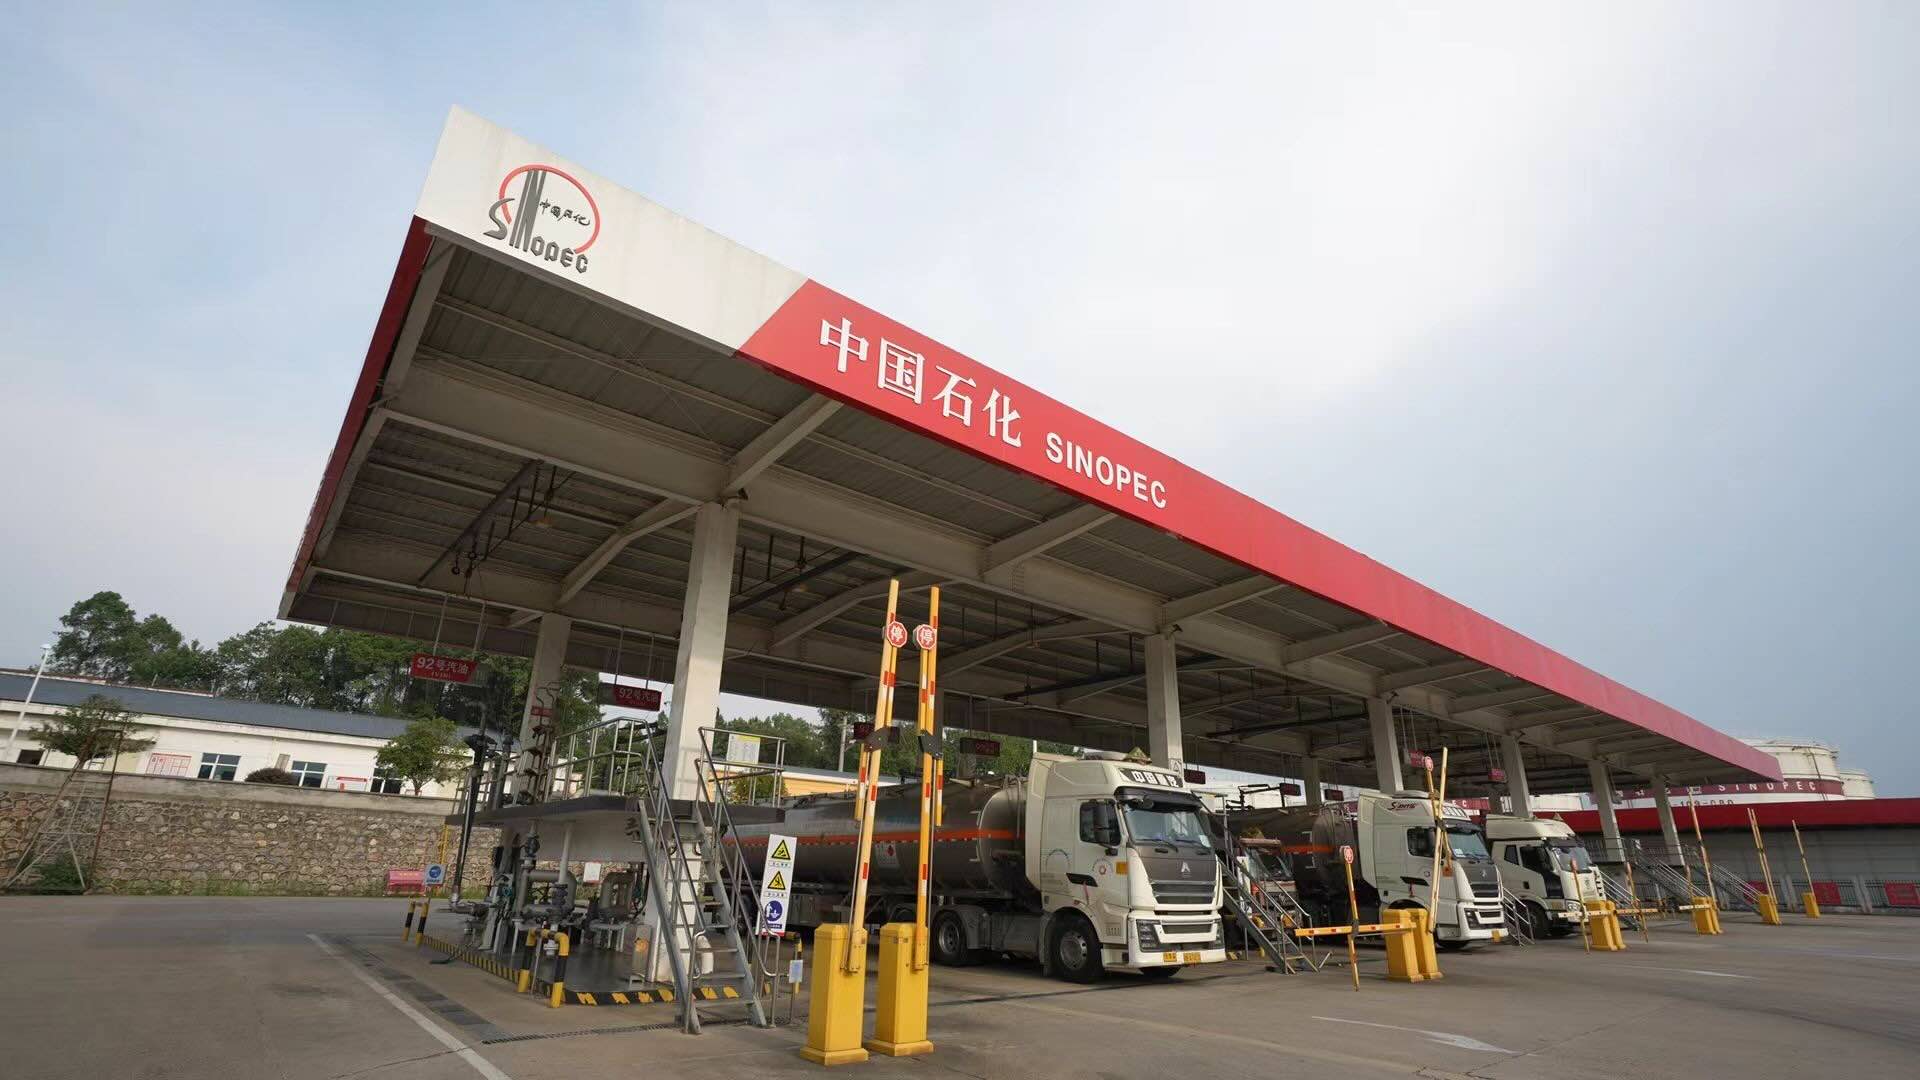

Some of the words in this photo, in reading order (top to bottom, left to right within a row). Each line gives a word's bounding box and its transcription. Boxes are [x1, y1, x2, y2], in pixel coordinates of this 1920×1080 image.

[483, 169, 589, 274] SINOPEC
[539, 198, 591, 227] 中国石化
[818, 316, 1024, 450] 中国石化
[1045, 430, 1168, 510] SINOPEC
